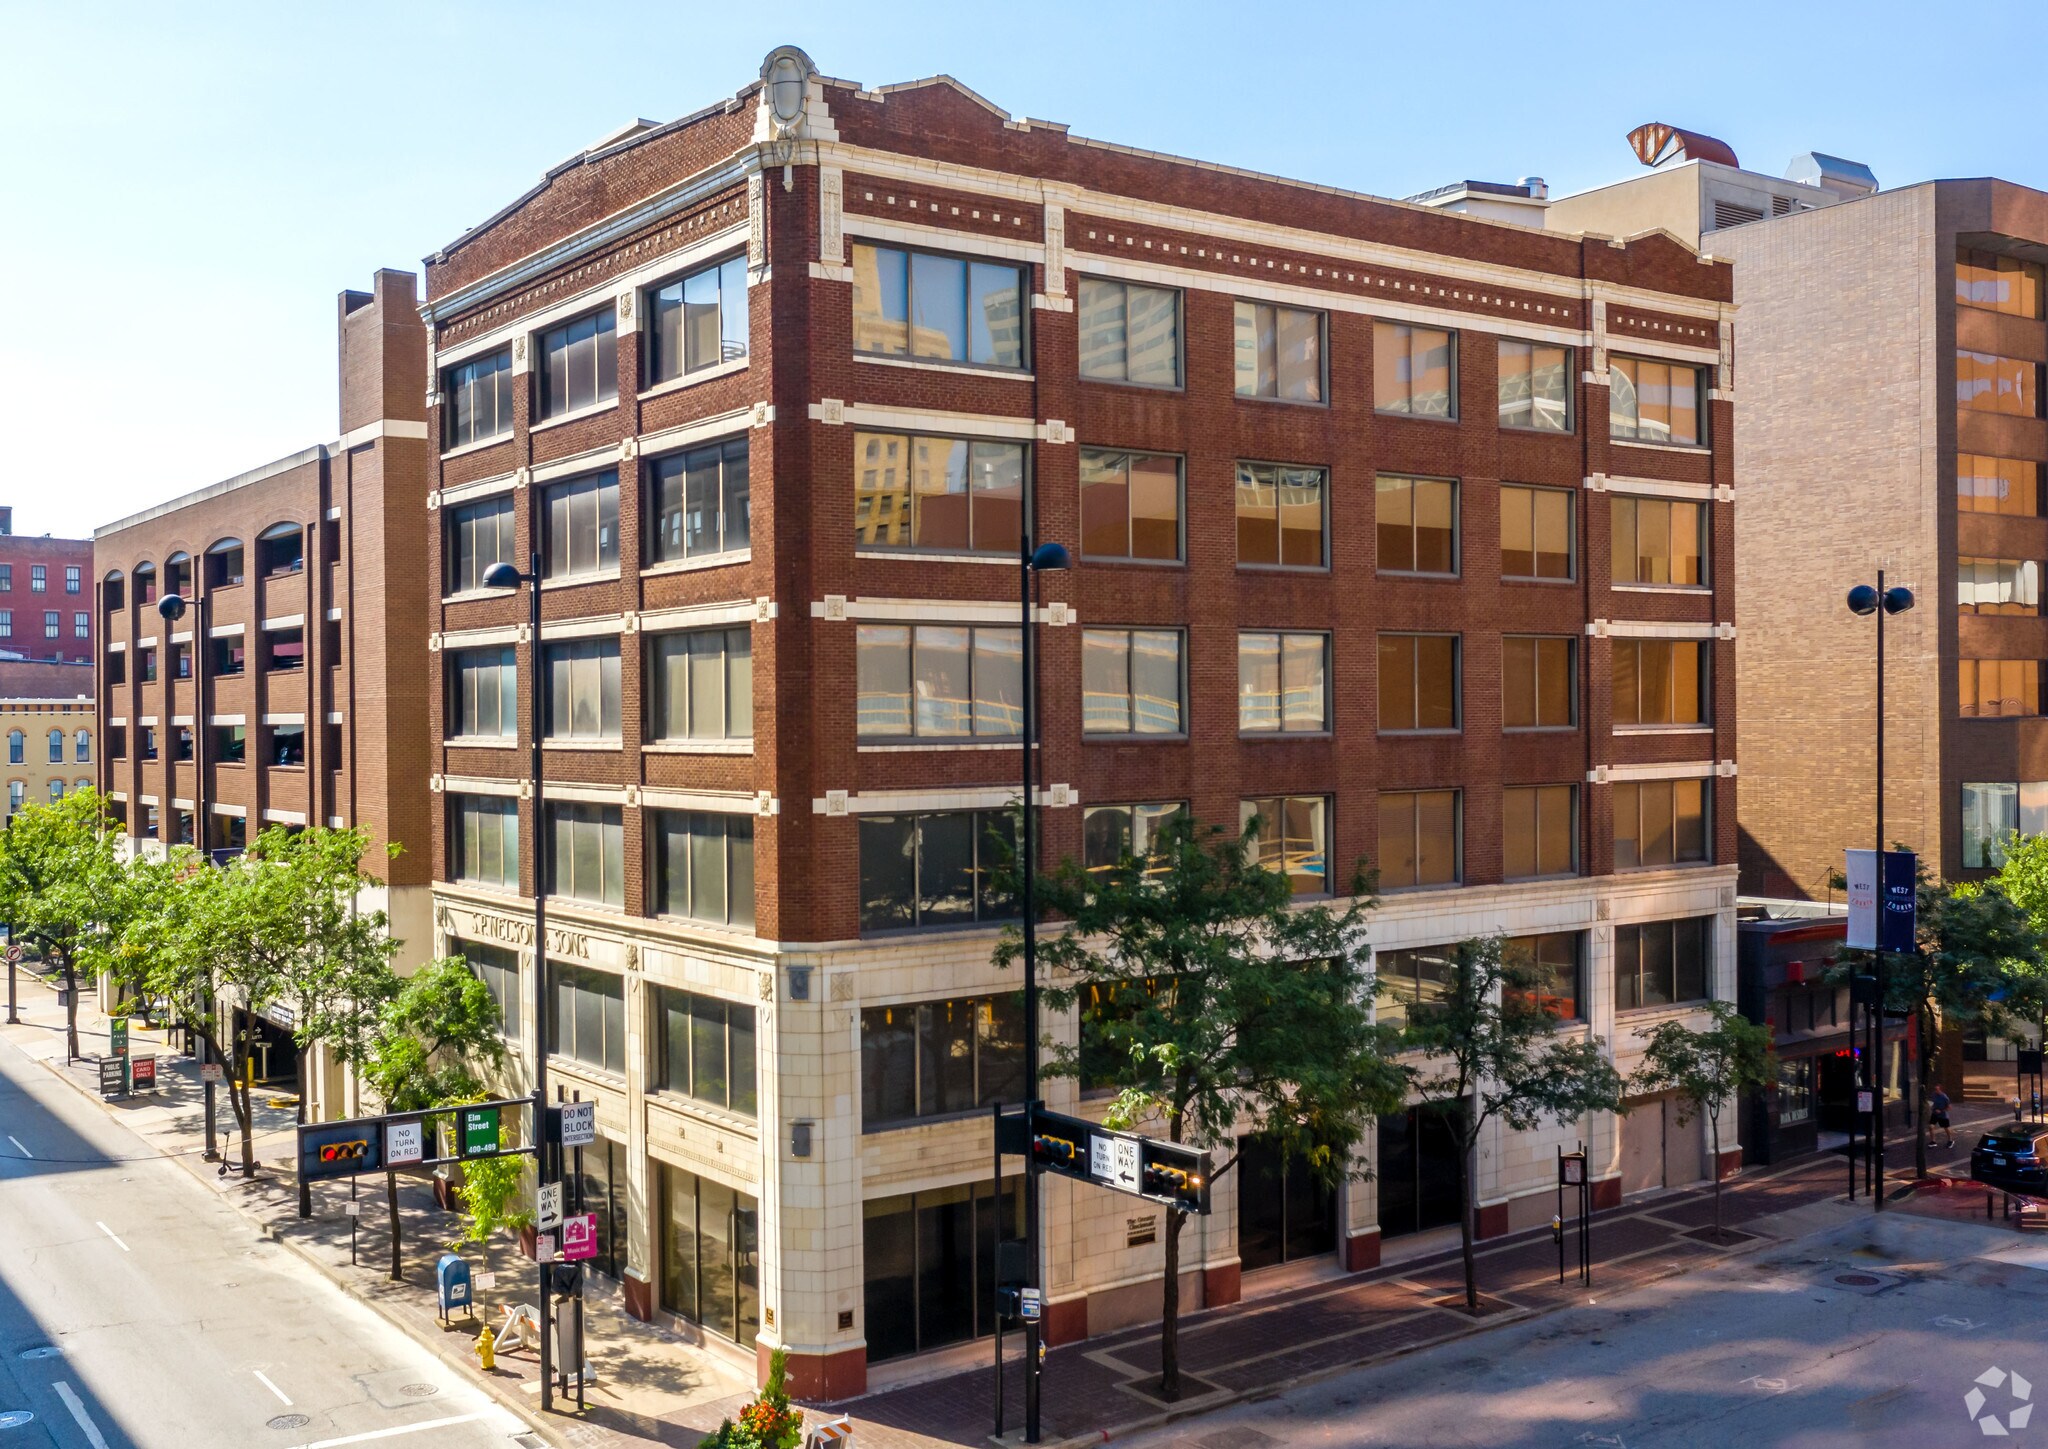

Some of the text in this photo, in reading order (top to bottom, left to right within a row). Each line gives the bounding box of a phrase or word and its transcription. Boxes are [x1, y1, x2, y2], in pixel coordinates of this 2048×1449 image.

[1854, 883, 1870, 891] WEST
[1891, 886, 1909, 895] WEST
[1887, 901, 1913, 911] FOURTH
[489, 915, 537, 946] NELSON
[104, 1063, 120, 1071] PUBLIC
[133, 1060, 153, 1068] CREDIT
[102, 1070, 122, 1079] PARKING
[468, 1113, 481, 1121] Elm
[564, 1106, 593, 1120] DO NOT
[468, 1121, 490, 1131] Street
[564, 1120, 593, 1133] BLOCK
[398, 1129, 411, 1137] NO
[564, 1132, 594, 1142] INTERSECTION
[395, 1138, 415, 1147] TURN
[1098, 1142, 1107, 1151] NO
[390, 1147, 419, 1157] ON RED
[468, 1143, 497, 1154] 400-499
[1118, 1143, 1134, 1157] ONE
[1096, 1152, 1110, 1162] TURN
[1093, 1161, 1113, 1173] ON RED
[1118, 1155, 1135, 1170] WAY
[541, 1187, 558, 1201] ONE
[541, 1199, 558, 1212] WAY
